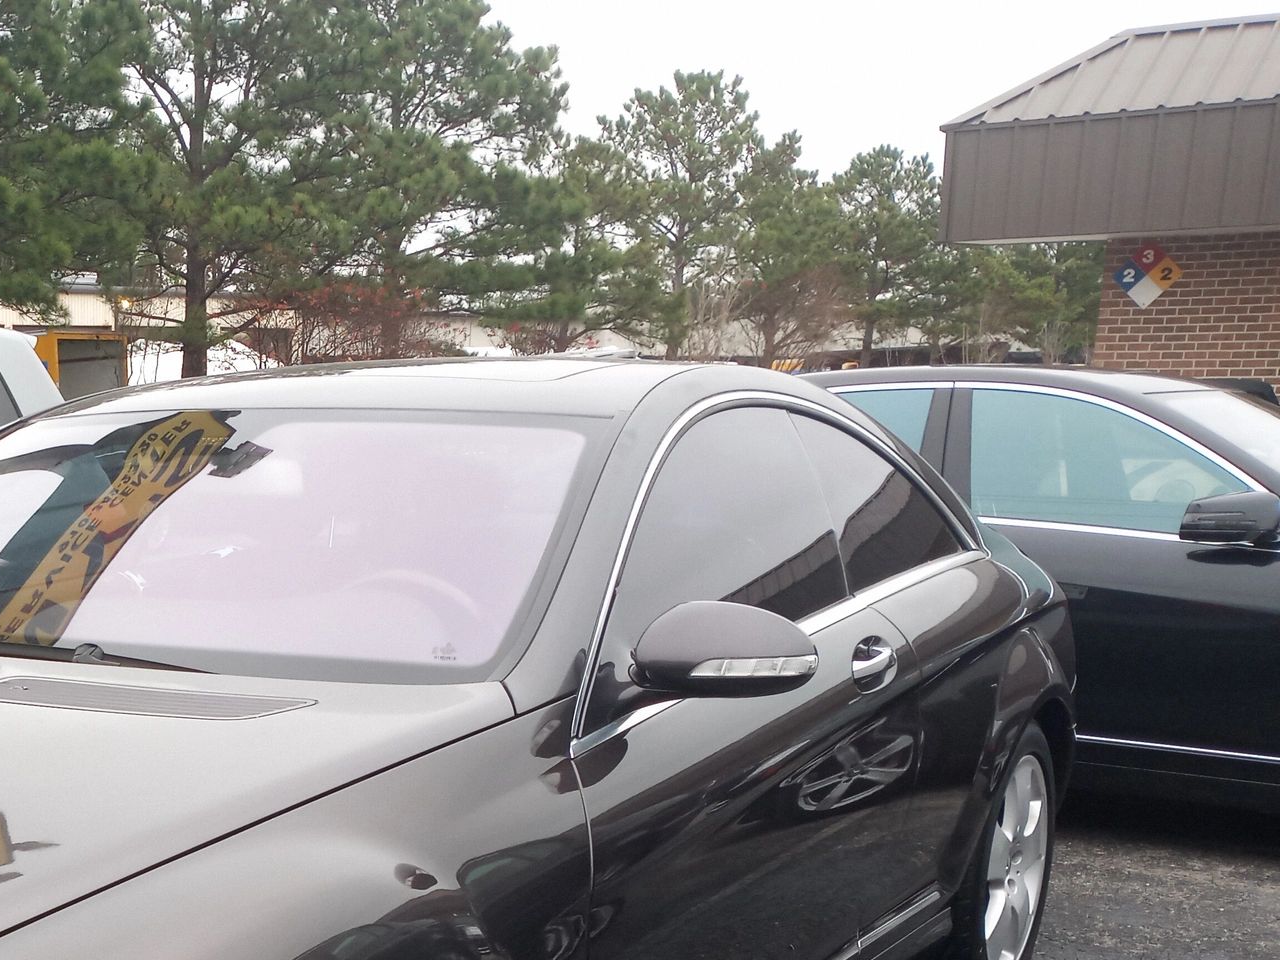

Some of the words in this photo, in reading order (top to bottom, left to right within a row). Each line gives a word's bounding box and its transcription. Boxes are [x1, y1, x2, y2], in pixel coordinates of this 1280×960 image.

[1142, 249, 1155, 264] 3
[1122, 268, 1136, 283] 2
[1159, 267, 1173, 281] 2
